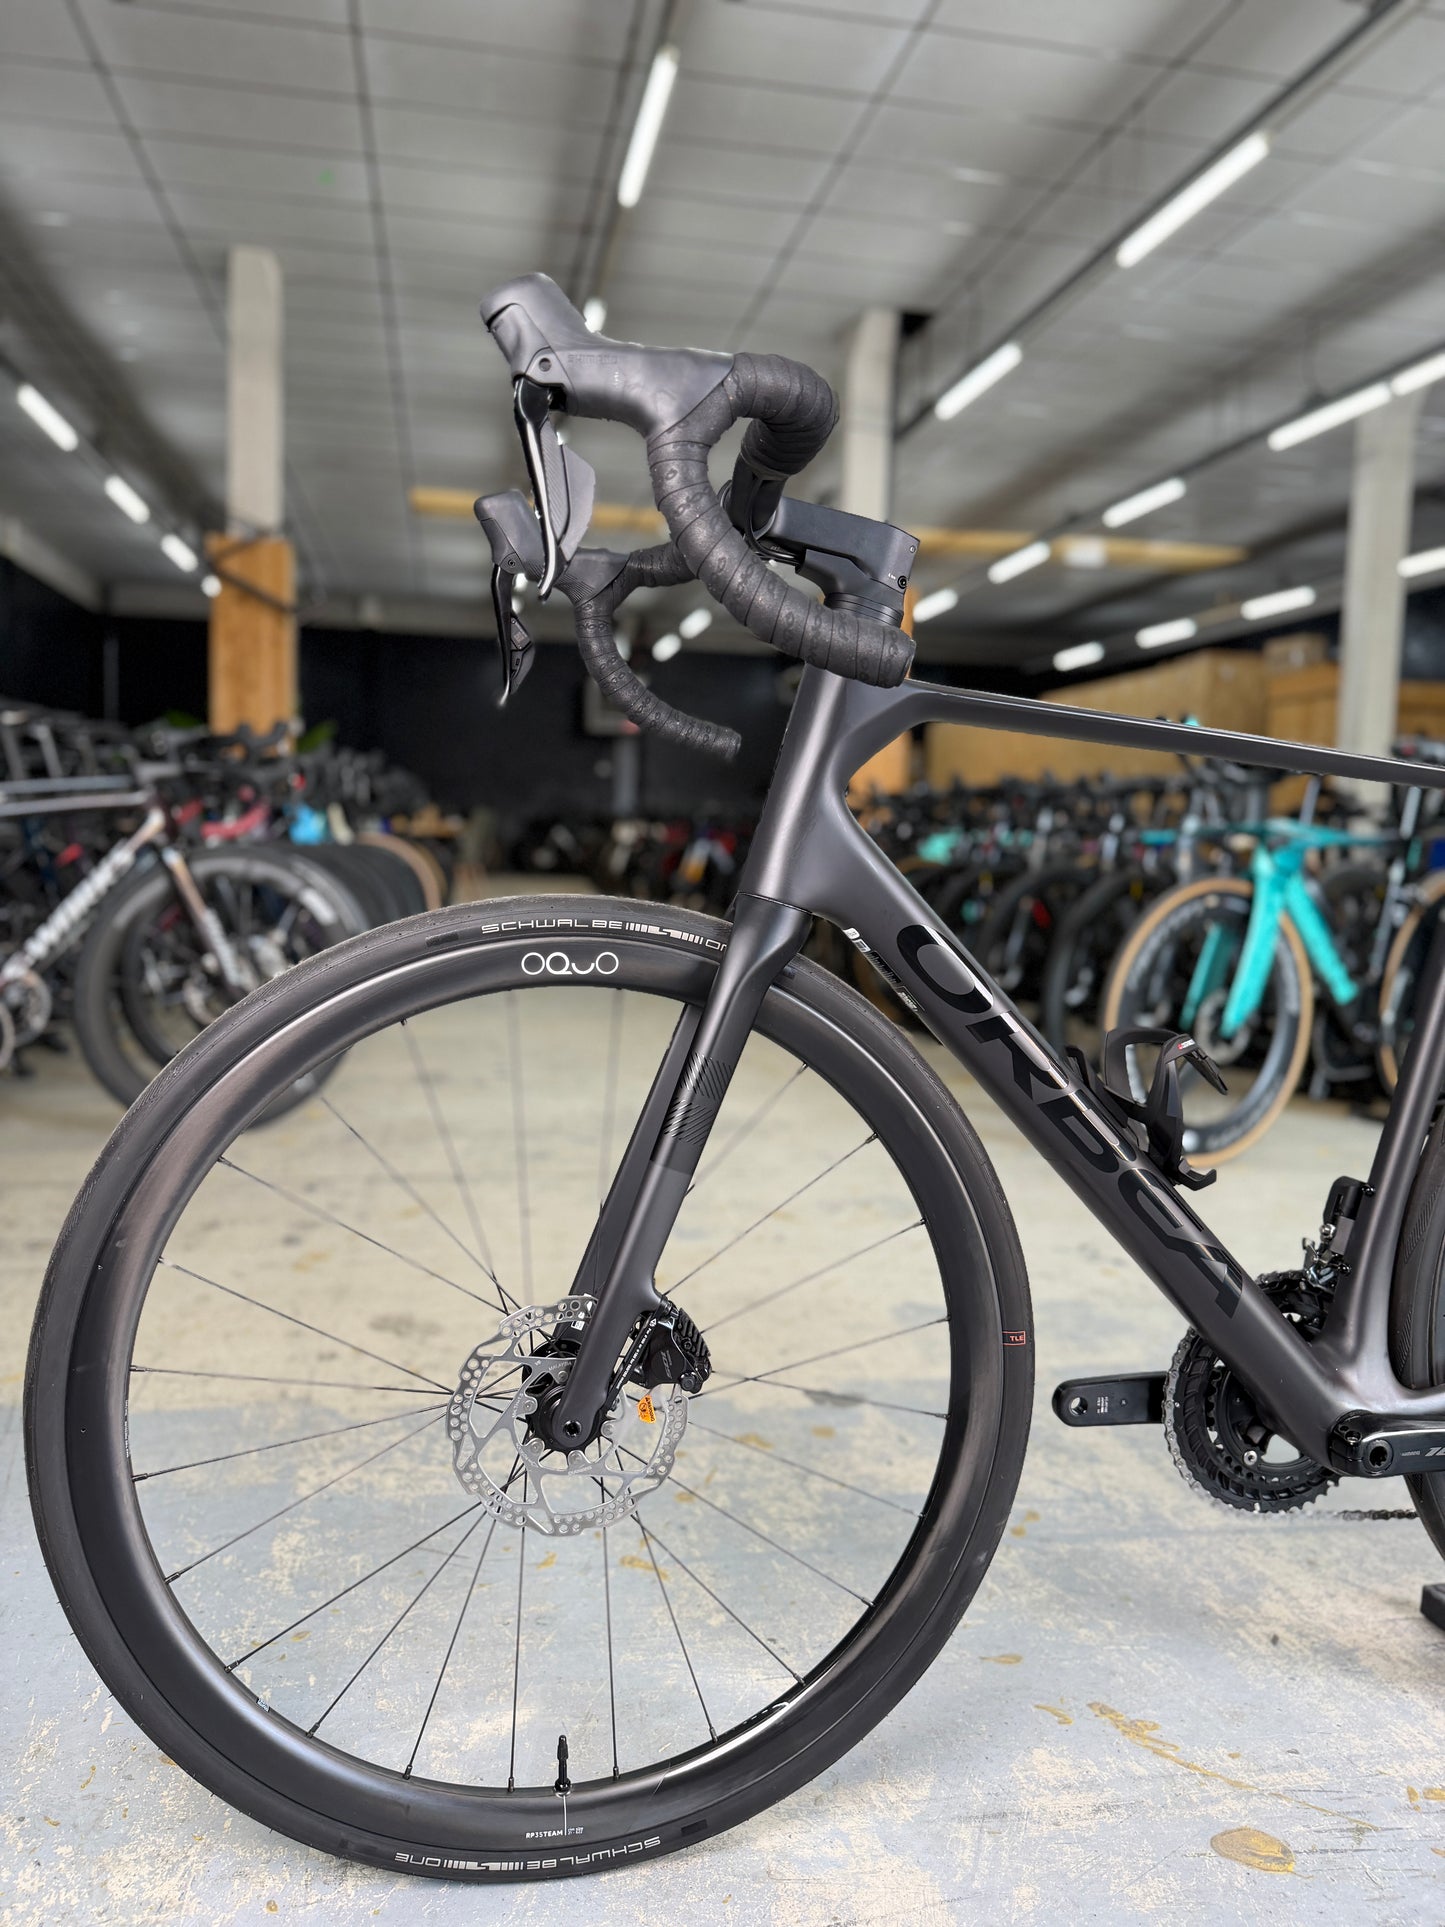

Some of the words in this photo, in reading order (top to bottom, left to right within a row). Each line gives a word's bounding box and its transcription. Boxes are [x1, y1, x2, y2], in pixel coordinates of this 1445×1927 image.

[481, 918, 622, 934] SCHWALBE
[896, 924, 1244, 1319] ORBEA
[395, 1852, 441, 1868] ONE
[526, 1836, 661, 1870] SCHWALBE
